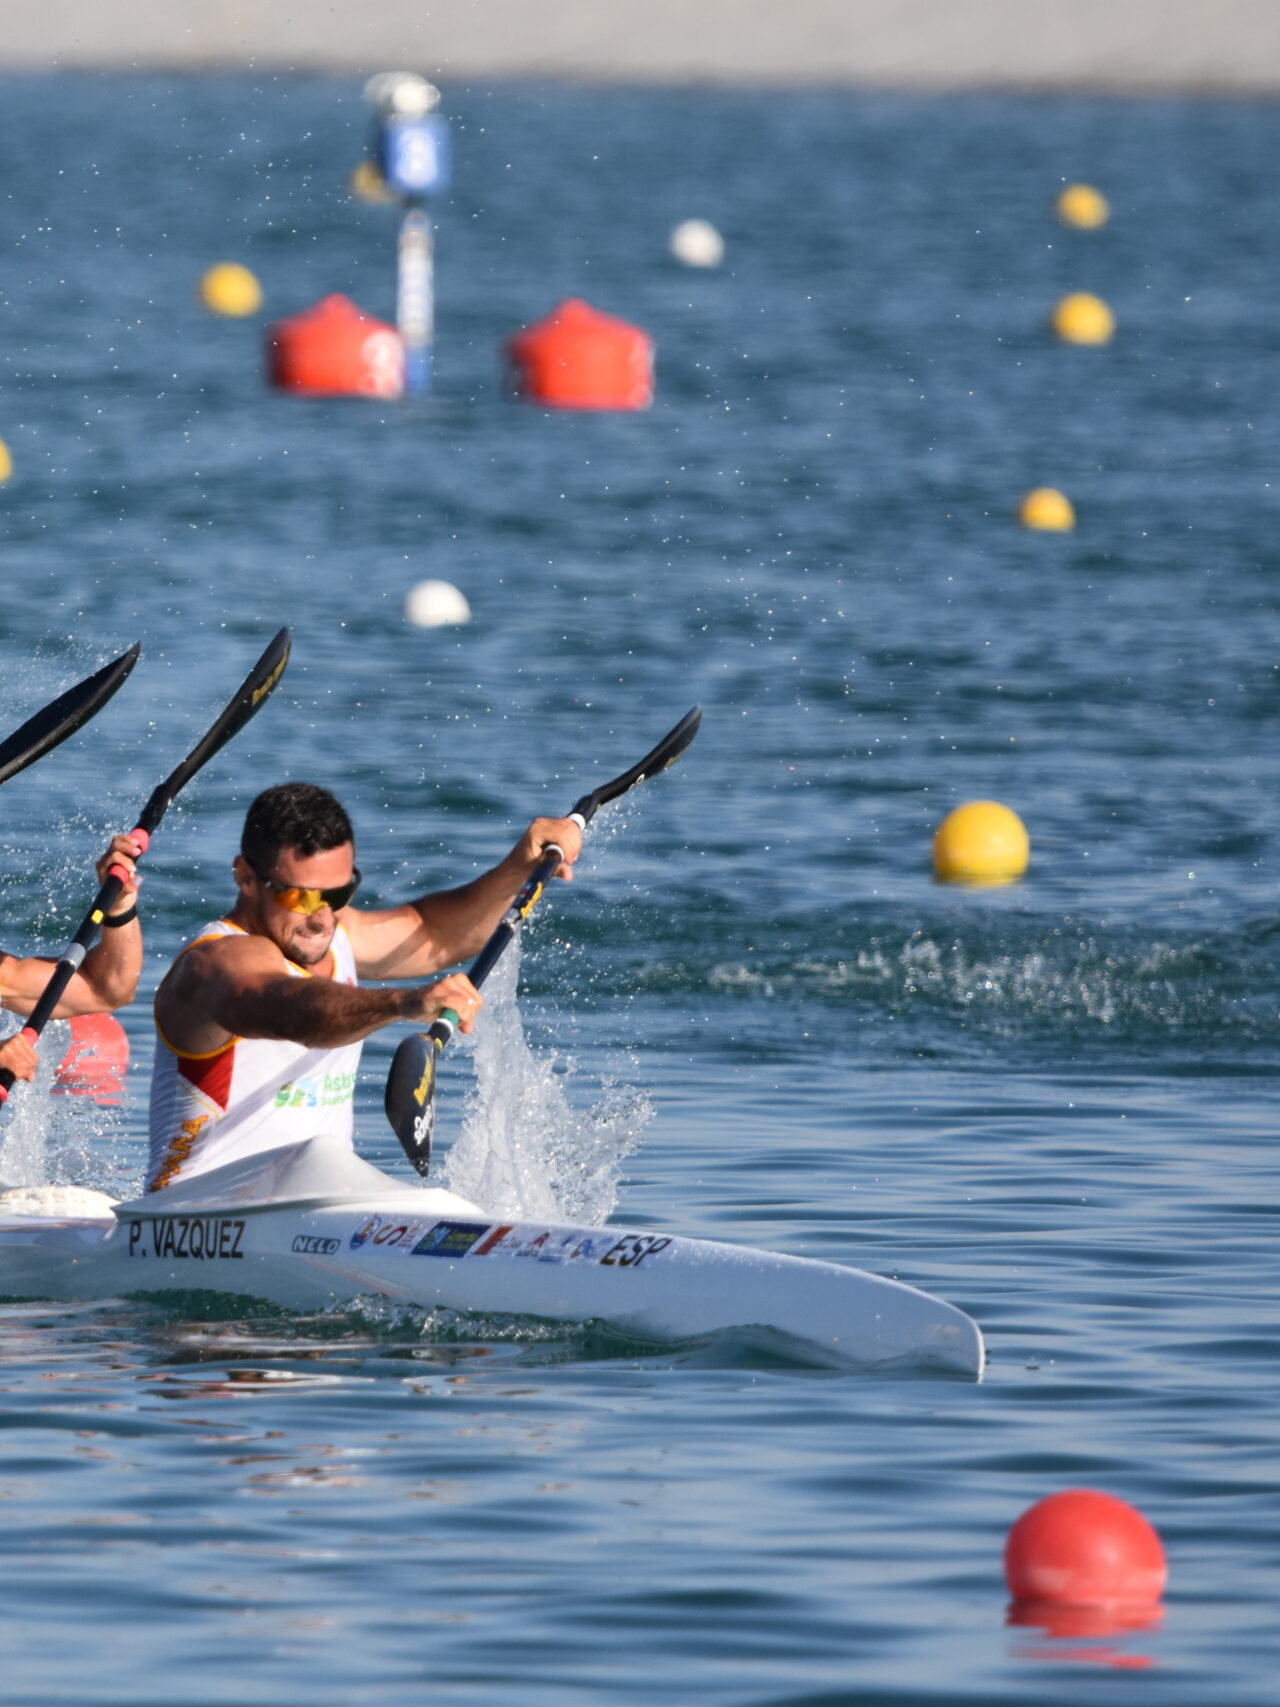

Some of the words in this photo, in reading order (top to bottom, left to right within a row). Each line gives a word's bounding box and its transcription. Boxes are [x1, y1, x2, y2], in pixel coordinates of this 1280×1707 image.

[129, 1220, 147, 1257] P.
[152, 1218, 246, 1261] VAZQUEZ
[293, 1236, 338, 1254] NELO
[600, 1234, 673, 1267] ESP
